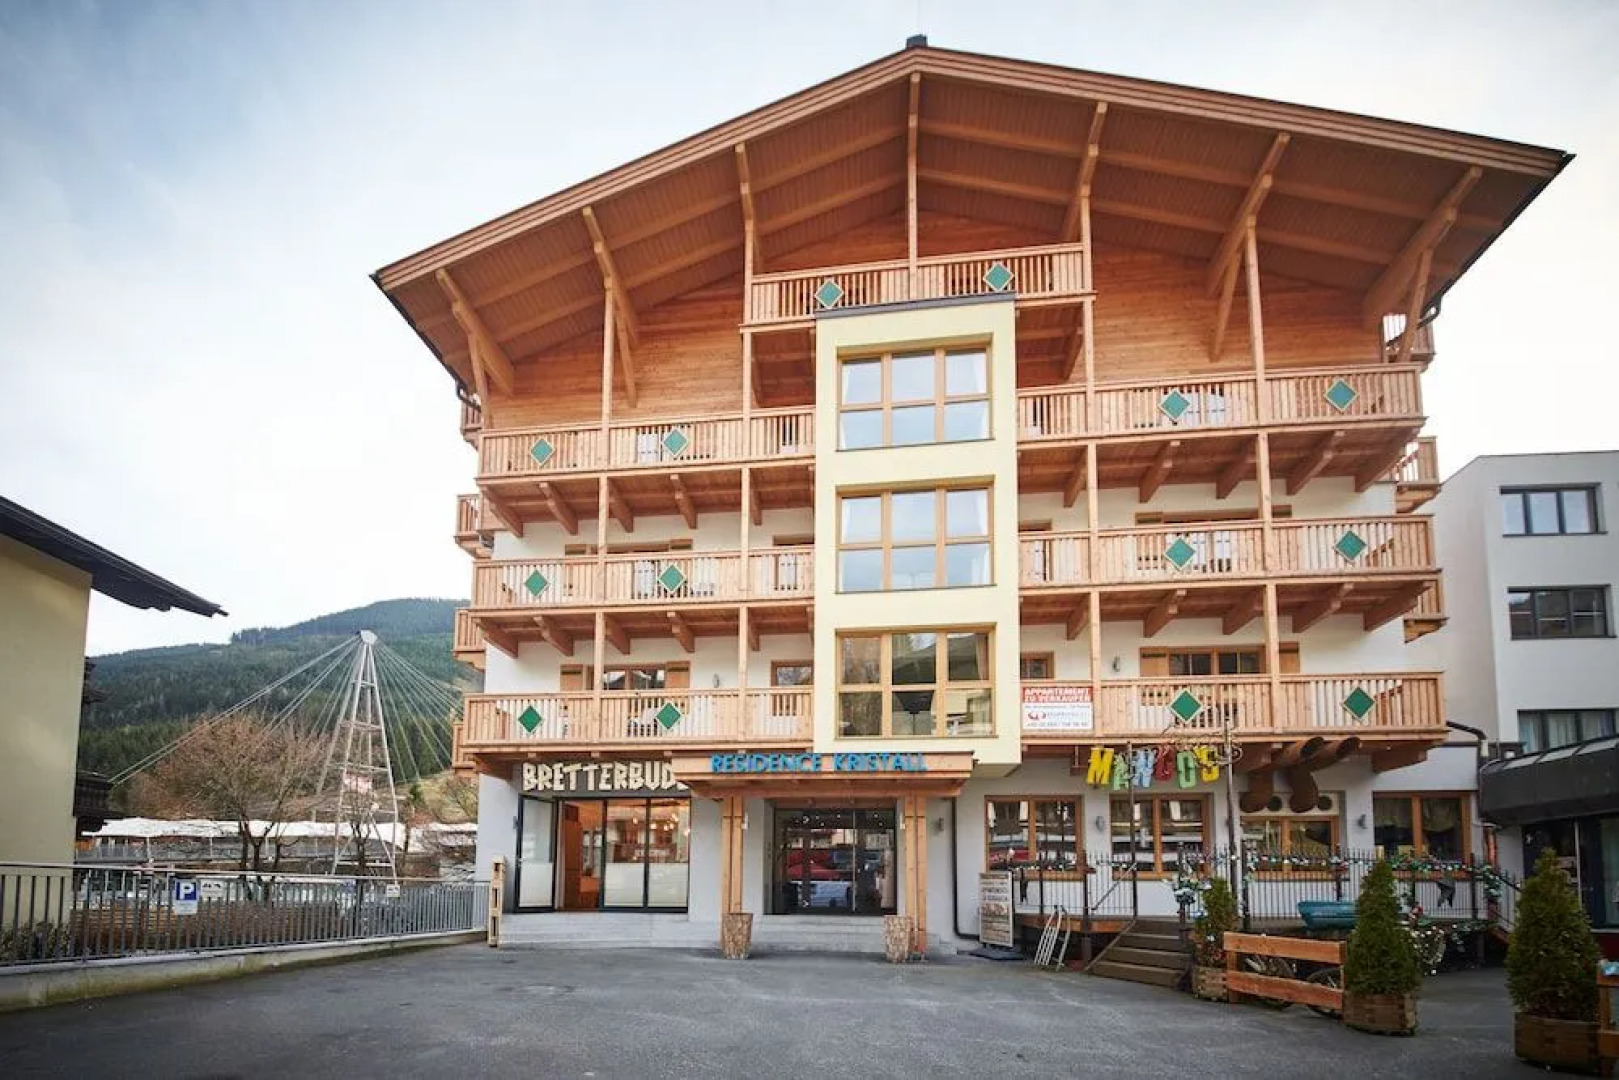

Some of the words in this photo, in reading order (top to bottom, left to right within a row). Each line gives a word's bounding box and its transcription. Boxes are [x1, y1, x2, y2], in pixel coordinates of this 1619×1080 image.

[711, 753, 822, 773] RESIDENCE
[833, 752, 928, 772] KRISTALL
[522, 760, 689, 791] BRETTERBUD
[180, 882, 195, 900] P
